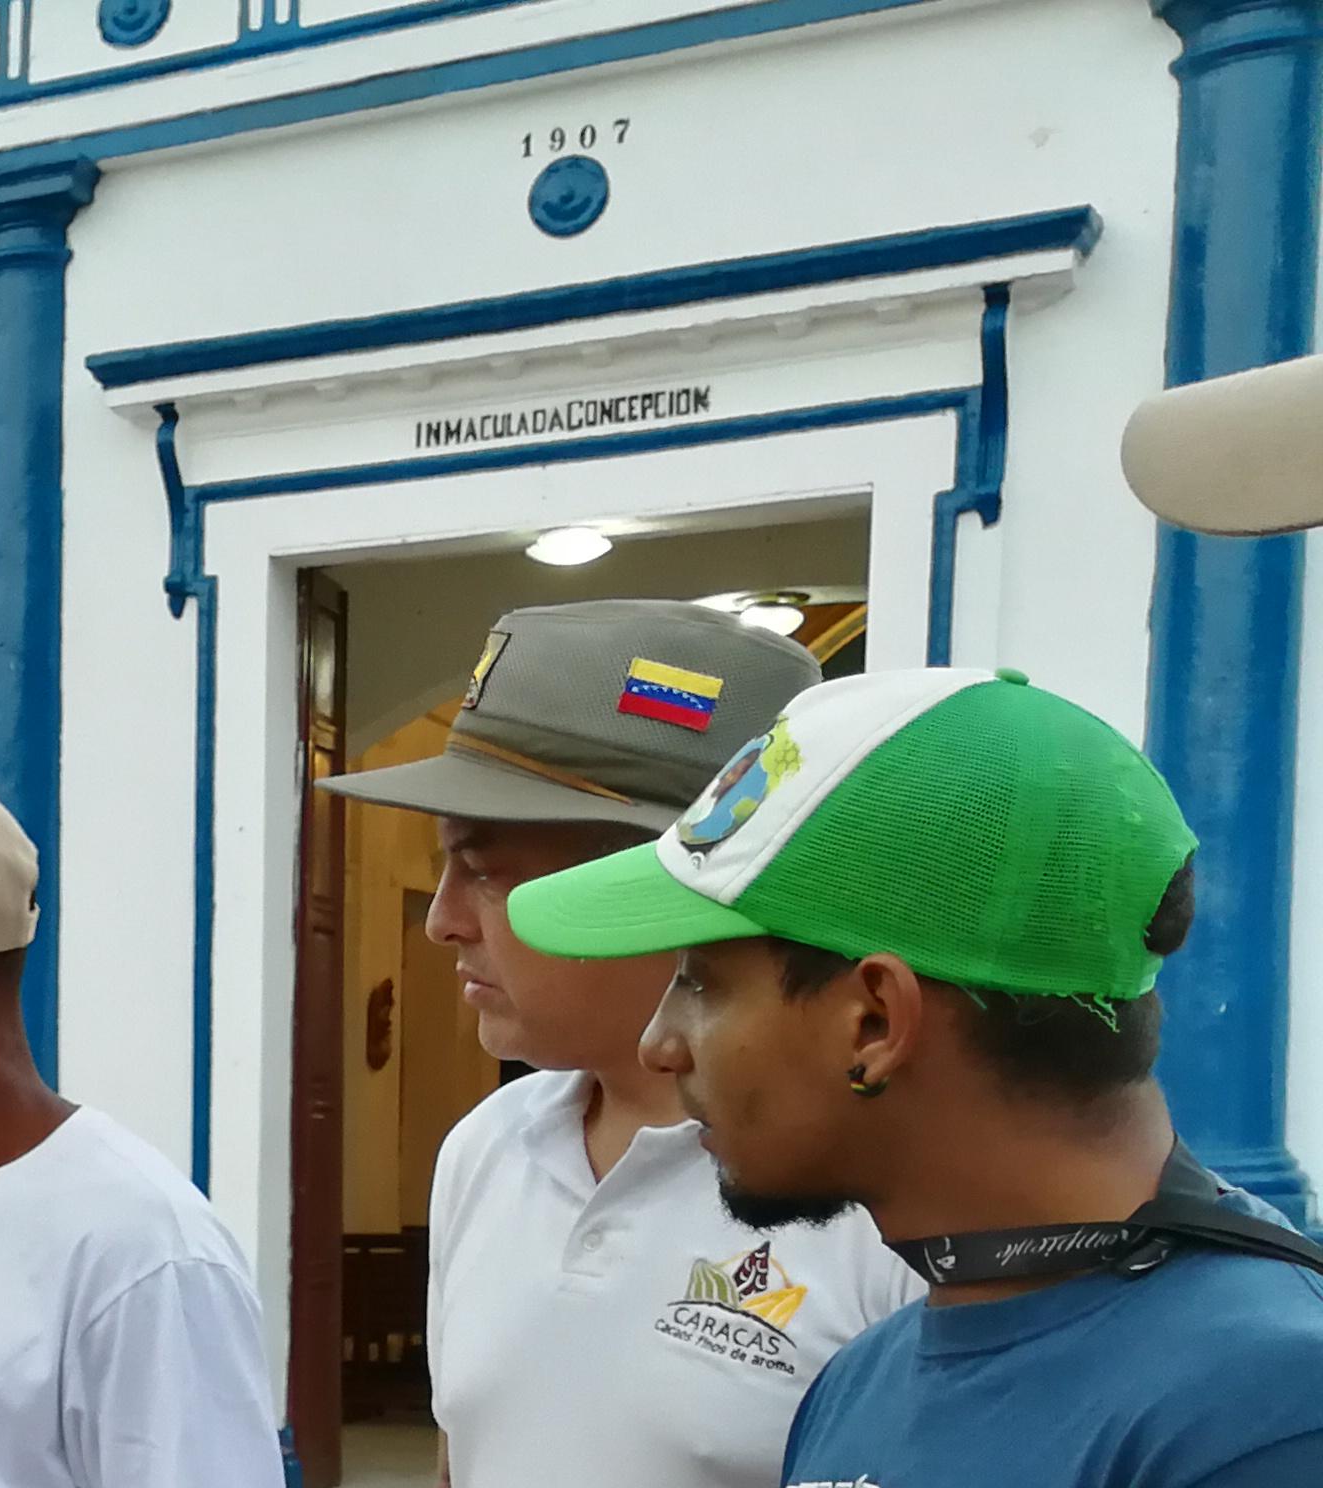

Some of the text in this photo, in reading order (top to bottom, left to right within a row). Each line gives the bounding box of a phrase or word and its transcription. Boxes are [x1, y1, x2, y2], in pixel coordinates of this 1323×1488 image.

[520, 118, 630, 158] 1907
[415, 385, 711, 449] INMACULADA CONCEPCION
[654, 1318, 796, 1376] Cacaos finos de aroma
[673, 1306, 781, 1356] CARACAS
